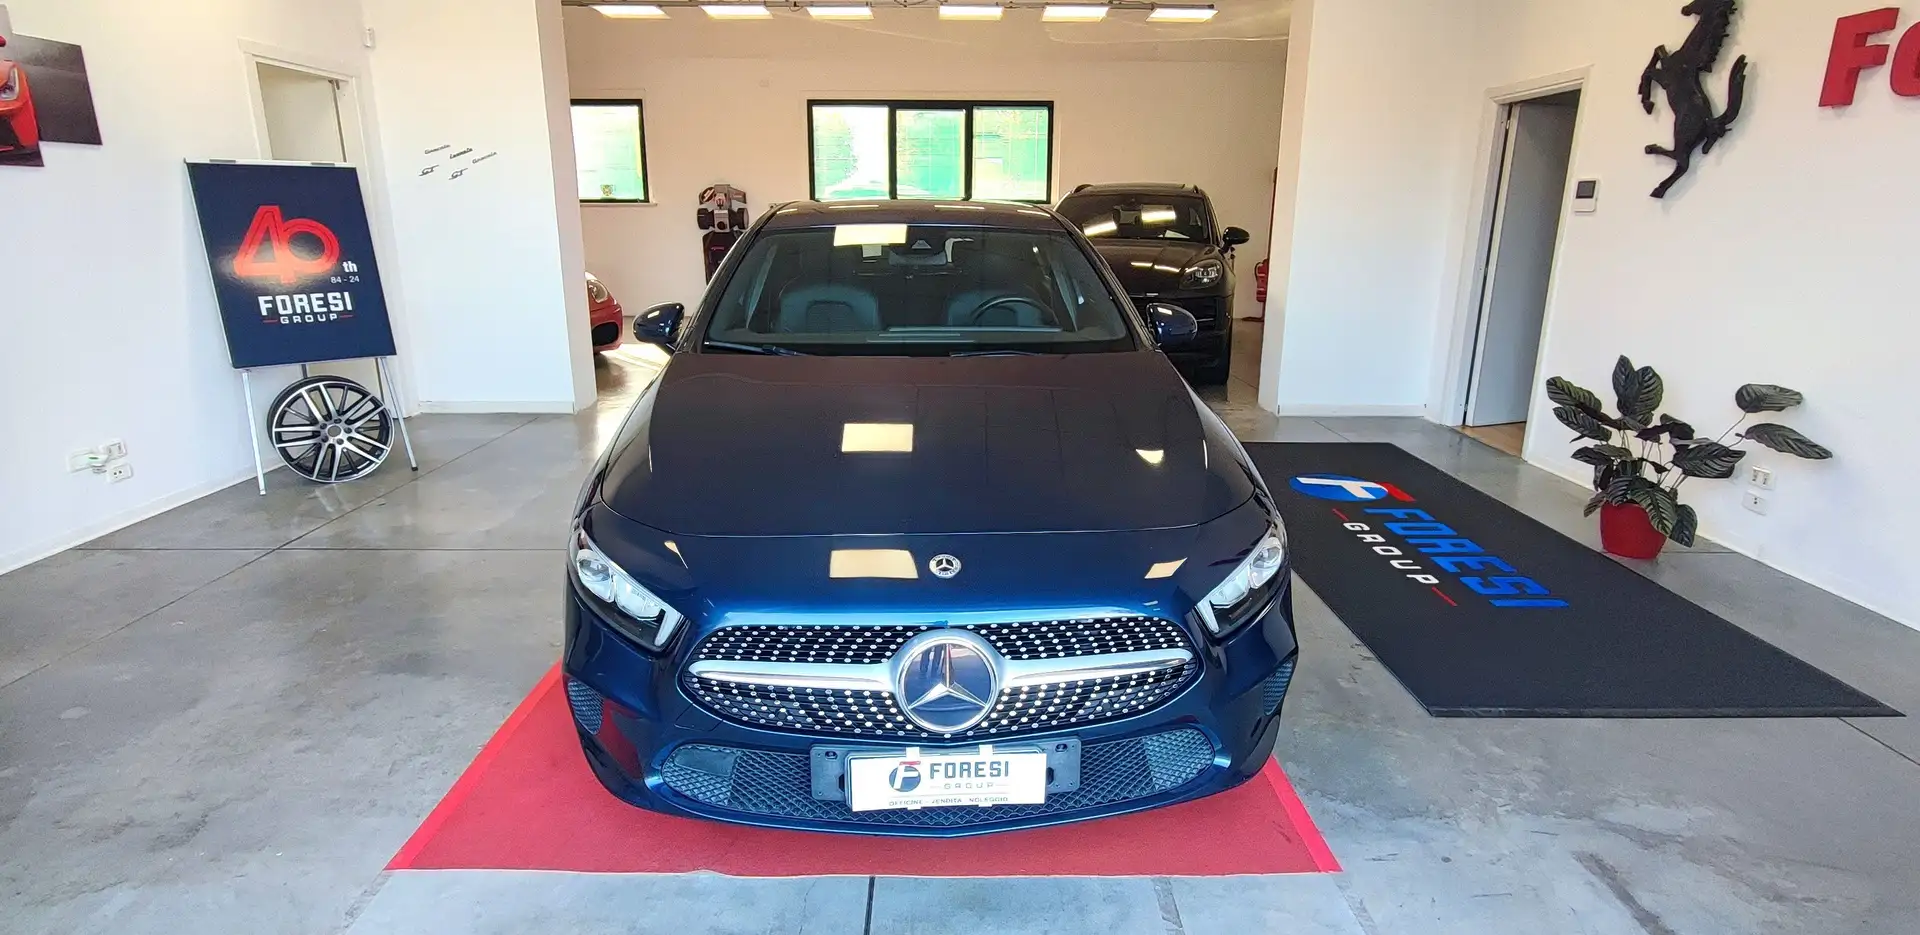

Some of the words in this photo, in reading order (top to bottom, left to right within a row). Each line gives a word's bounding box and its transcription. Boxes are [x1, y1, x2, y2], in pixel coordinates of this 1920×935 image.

[342, 261, 358, 272] th
[330, 276, 342, 284] 84
[348, 275, 360, 283] 24
[257, 291, 353, 316] FORESI
[280, 313, 338, 324] GROUP
[1343, 522, 1440, 585] GROUP
[1363, 508, 1569, 607] FORESI
[929, 760, 1009, 780] FORESI
